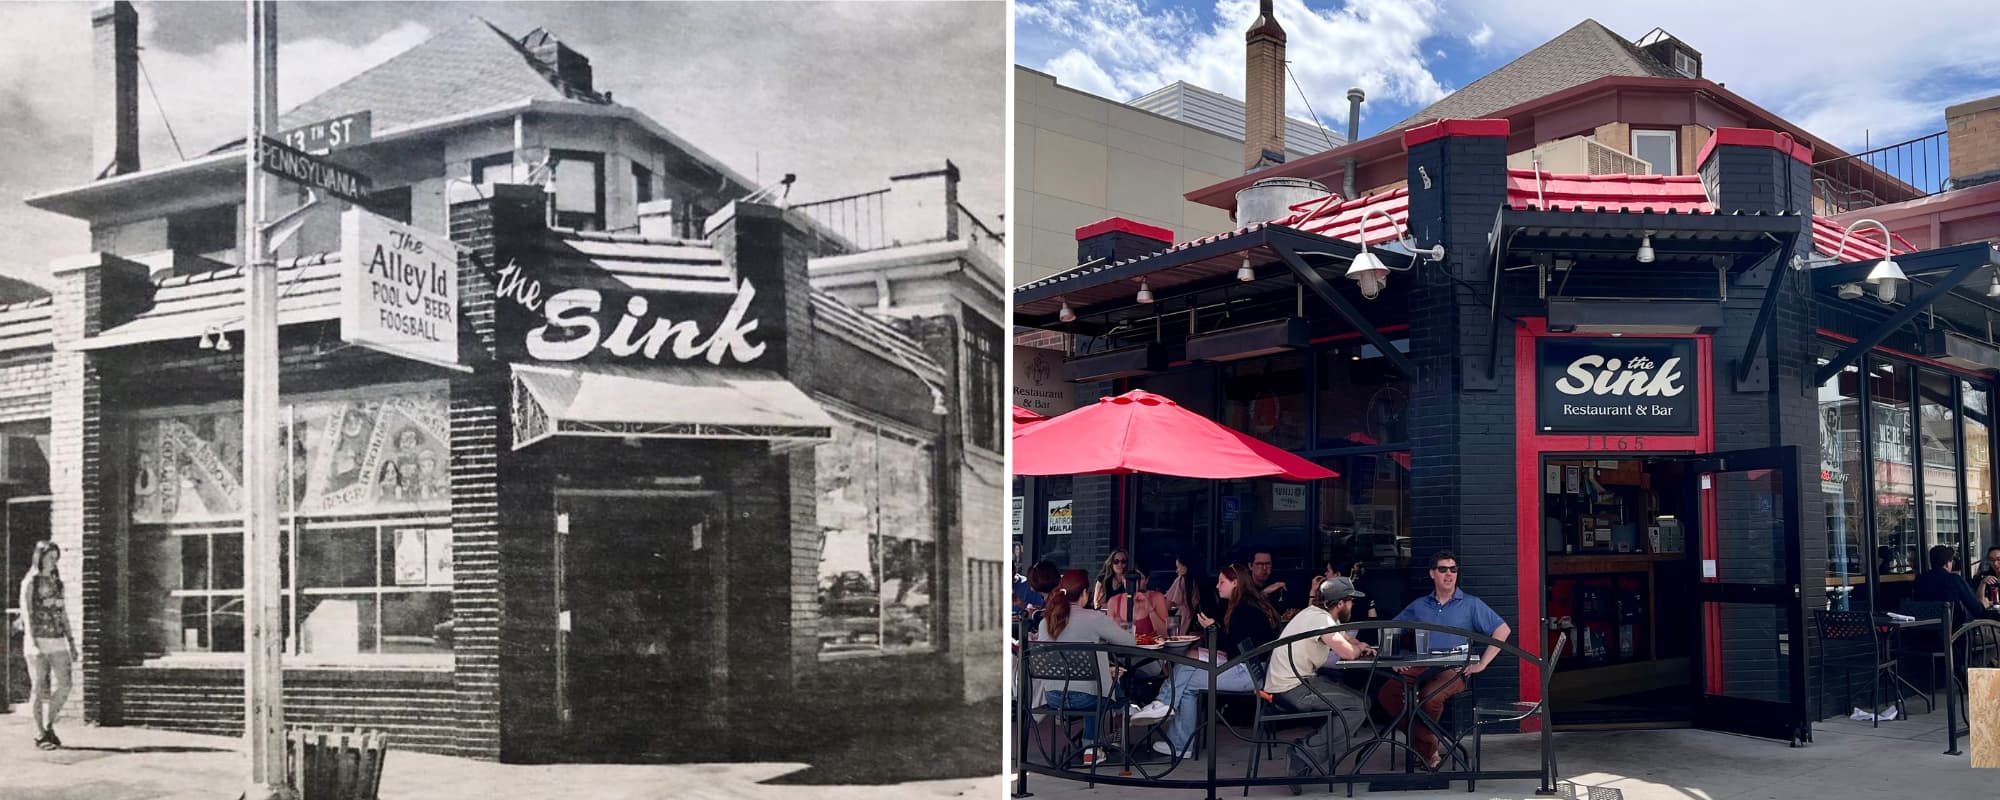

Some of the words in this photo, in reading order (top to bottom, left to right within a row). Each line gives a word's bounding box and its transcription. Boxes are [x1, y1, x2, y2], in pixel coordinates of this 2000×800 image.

[329, 118, 353, 147] ST
[260, 141, 359, 199] PENNSYLVANIA
[388, 230, 424, 255] The
[368, 243, 427, 306] Alley
[371, 280, 403, 309] POOL
[423, 295, 453, 323] BEER
[495, 257, 543, 311] the
[525, 276, 767, 366] Sink
[379, 308, 441, 342] FOOSBALL
[1626, 355, 1656, 370] the
[1555, 354, 1685, 397] Sink
[1013, 384, 1064, 399] Restaurant
[1023, 398, 1032, 408] &
[1034, 399, 1051, 409] Bar
[1562, 403, 1633, 416] Restaurant
[1635, 404, 1649, 416] &
[1651, 404, 1674, 416] Bar
[1585, 435, 1646, 450] 1165
[1879, 423, 1901, 444] WE'RE
[1880, 441, 1902, 461] HIRING
